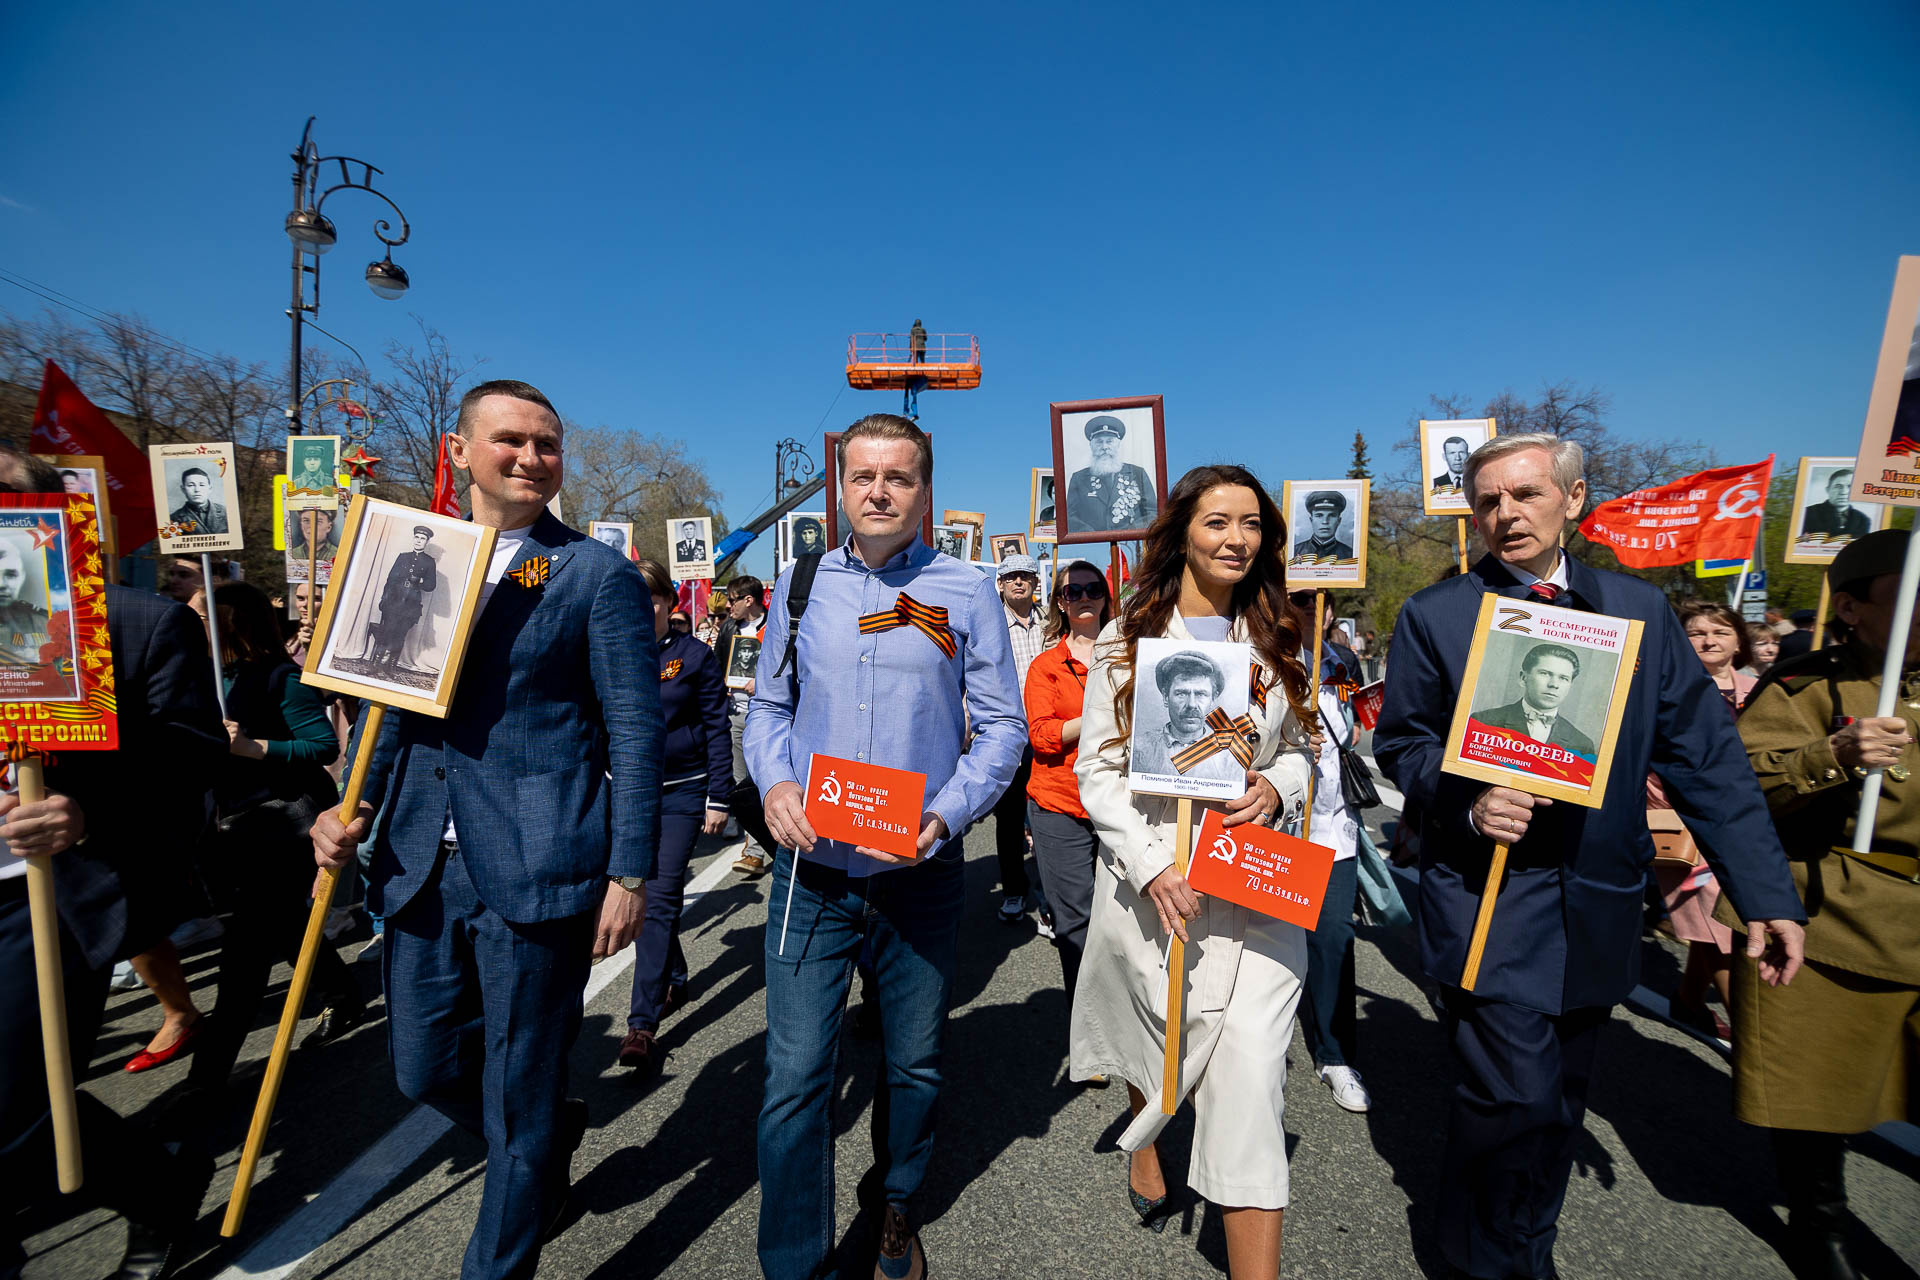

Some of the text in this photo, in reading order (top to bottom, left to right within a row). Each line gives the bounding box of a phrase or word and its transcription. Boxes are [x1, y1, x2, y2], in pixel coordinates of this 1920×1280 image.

[1863, 482, 1915, 499] Ветеран
[1748, 572, 1763, 588] P
[1539, 617, 1618, 638] БЕССМЕРТНЫЙ
[1543, 628, 1616, 648] ПОЛК РОССИИ
[16, 724, 108, 742] ГЕРОЯМ!
[1468, 742, 1494, 753] БОРИС
[1471, 731, 1575, 764] ТИМОФЕЕВ
[1467, 749, 1532, 768] АЛЕКСАНДРОВИЧ
[1174, 777, 1191, 785] Иван
[852, 812, 864, 827] 79
[1243, 842, 1254, 852] 150
[1246, 874, 1261, 891] 79
